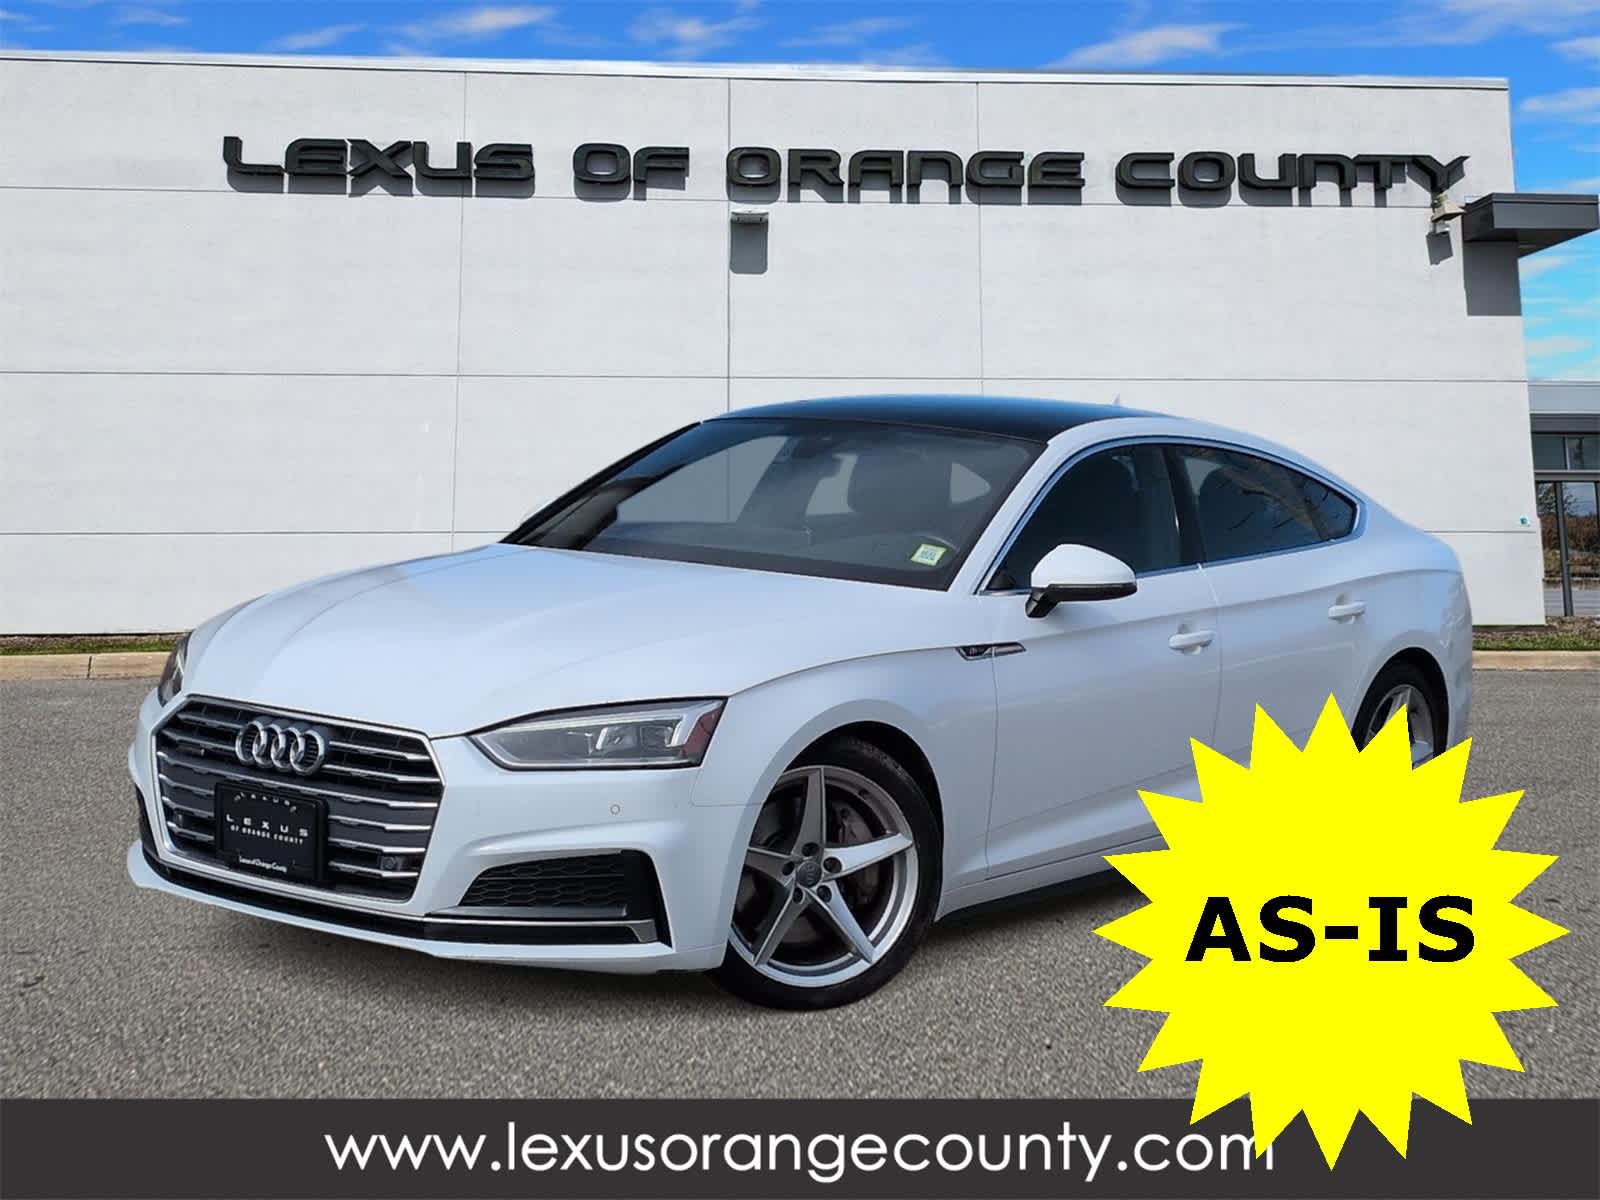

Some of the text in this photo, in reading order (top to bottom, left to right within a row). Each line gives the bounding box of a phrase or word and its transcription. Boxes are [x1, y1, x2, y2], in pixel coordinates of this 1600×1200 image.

[223, 136, 1470, 194] LEXUS OF ORANGE COUNTY
